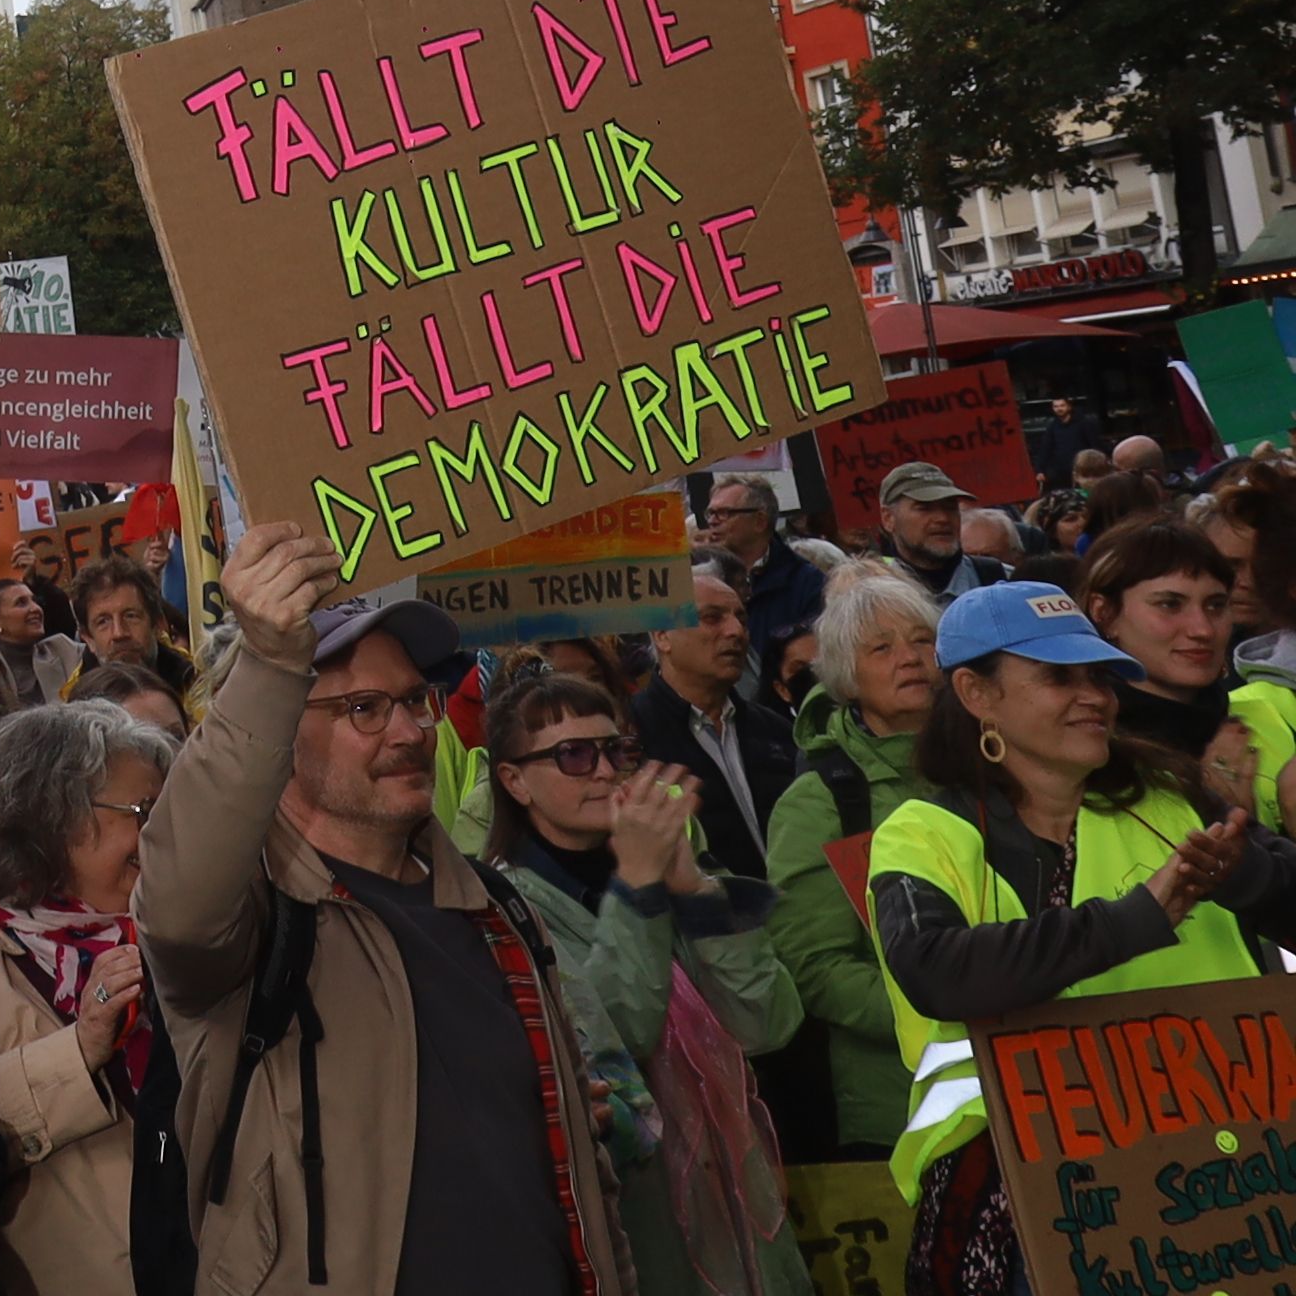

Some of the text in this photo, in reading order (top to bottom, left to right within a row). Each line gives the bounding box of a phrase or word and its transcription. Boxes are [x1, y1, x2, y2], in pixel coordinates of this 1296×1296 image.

[184, 29, 484, 203] FÄLLT
[330, 119, 683, 298] KULTUR
[1013, 258, 1087, 293] MARCO
[1087, 248, 1145, 282] POLO
[281, 258, 586, 450] FÄLLT
[25, 369, 49, 385] zu
[55, 367, 113, 386] mehr
[7, 429, 81, 451] Vielfalt
[529, 565, 670, 607] TRENNEN
[1036, 599, 1078, 614] FLO
